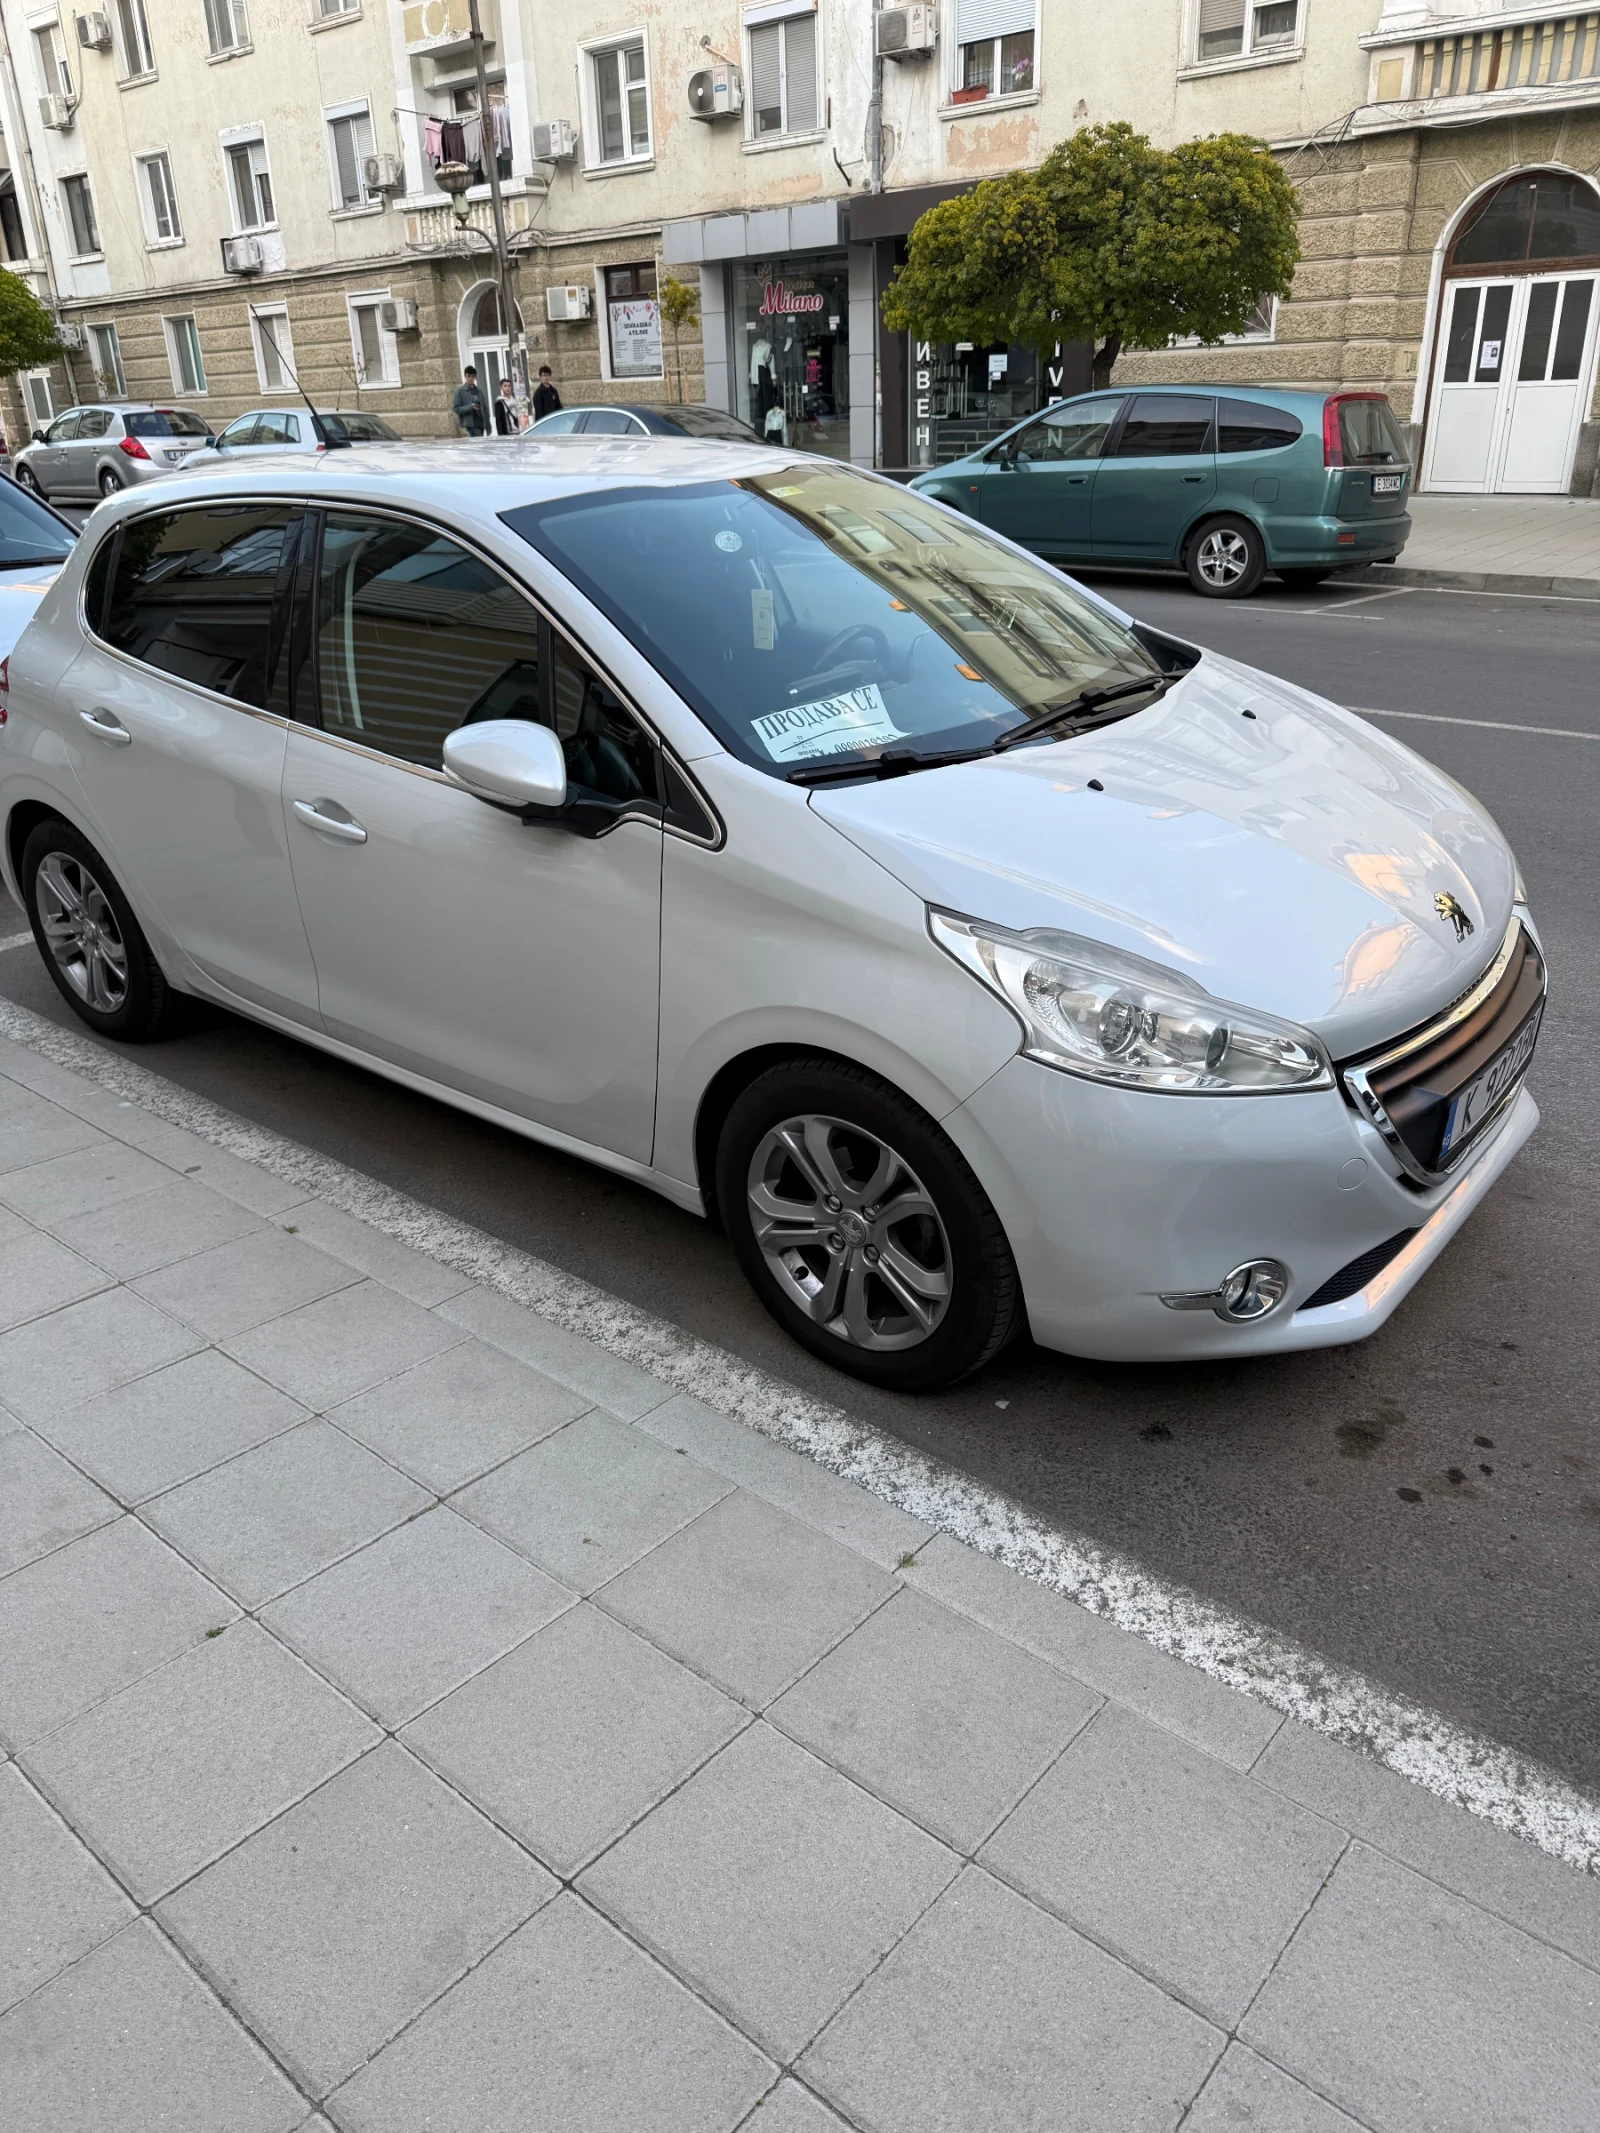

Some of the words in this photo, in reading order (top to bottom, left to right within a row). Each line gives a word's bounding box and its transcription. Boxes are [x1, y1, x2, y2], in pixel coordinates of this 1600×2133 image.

[760, 281, 824, 315] Milano
[623, 321, 653, 329] ШИВАШКО
[758, 696, 854, 741] ПРОДАВА
[851, 687, 879, 711] СЕ
[1461, 1083, 1479, 1133] K
